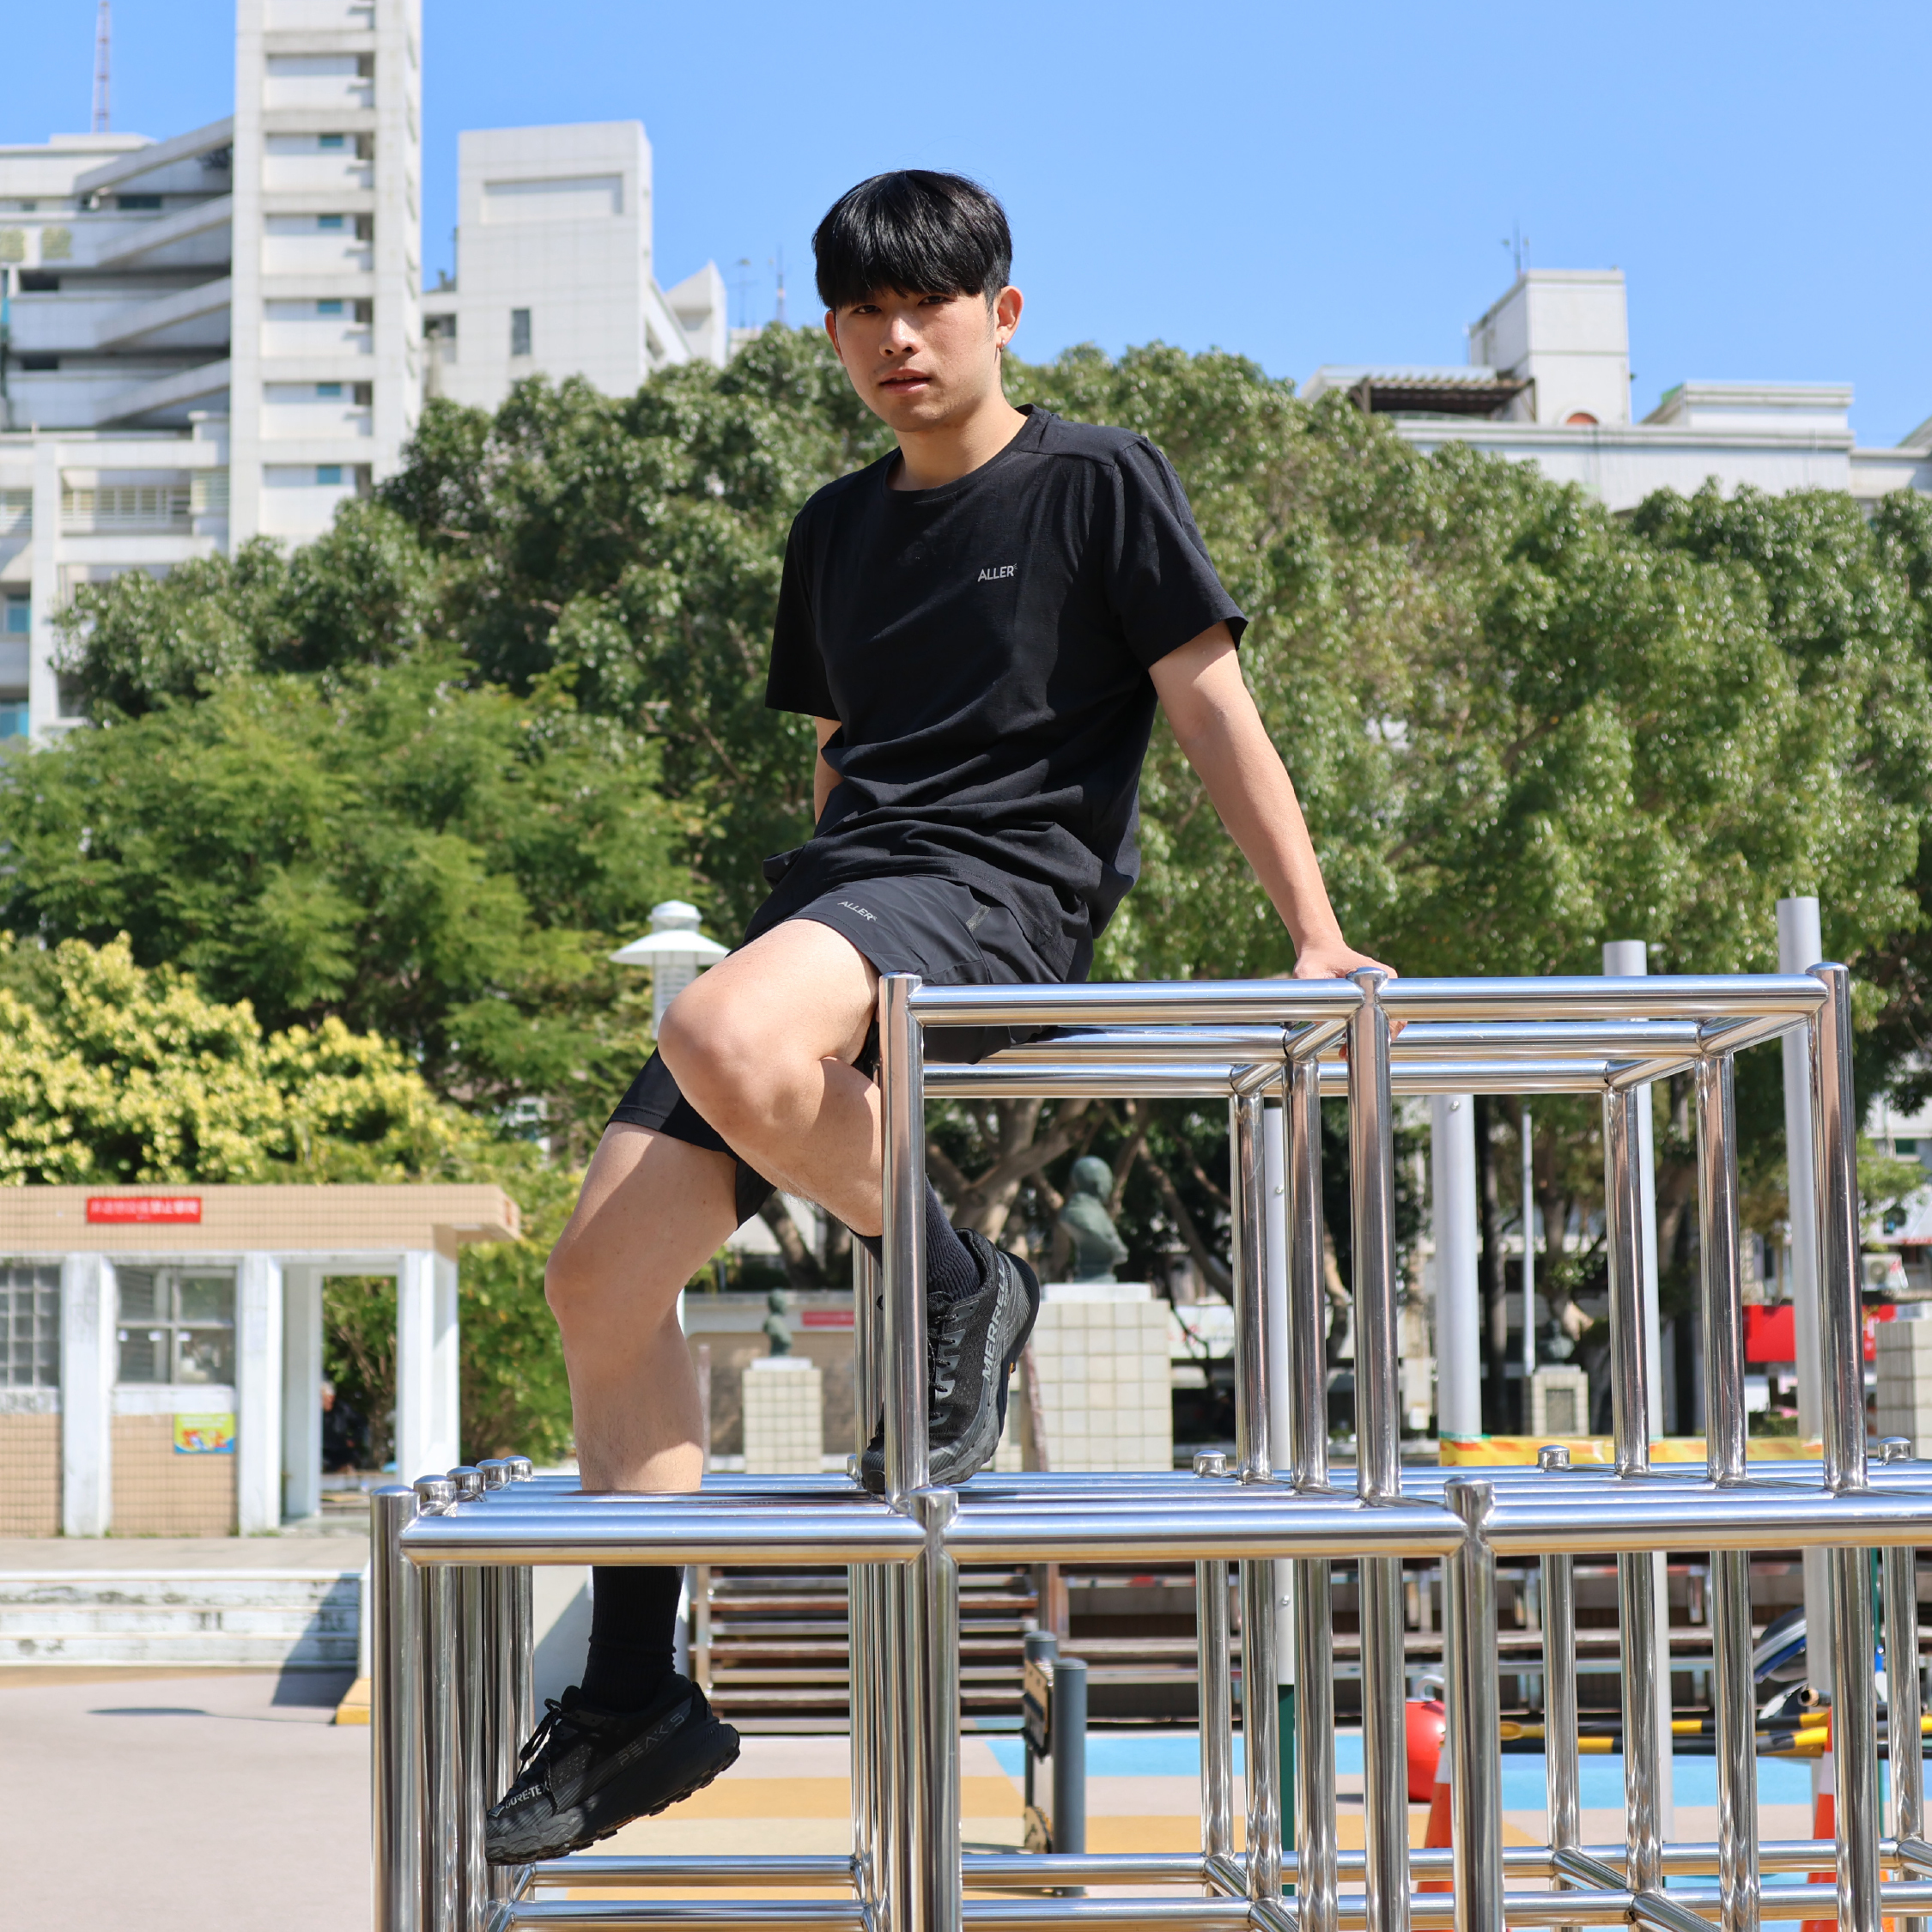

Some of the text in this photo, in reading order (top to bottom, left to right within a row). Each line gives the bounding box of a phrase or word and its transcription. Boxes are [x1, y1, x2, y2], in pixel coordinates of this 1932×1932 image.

[977, 565, 1014, 582] ALLER
[837, 901, 873, 920] ALLER
[981, 1264, 1006, 1382] MERRELL
[505, 1780, 550, 1809] GORE-TEX
